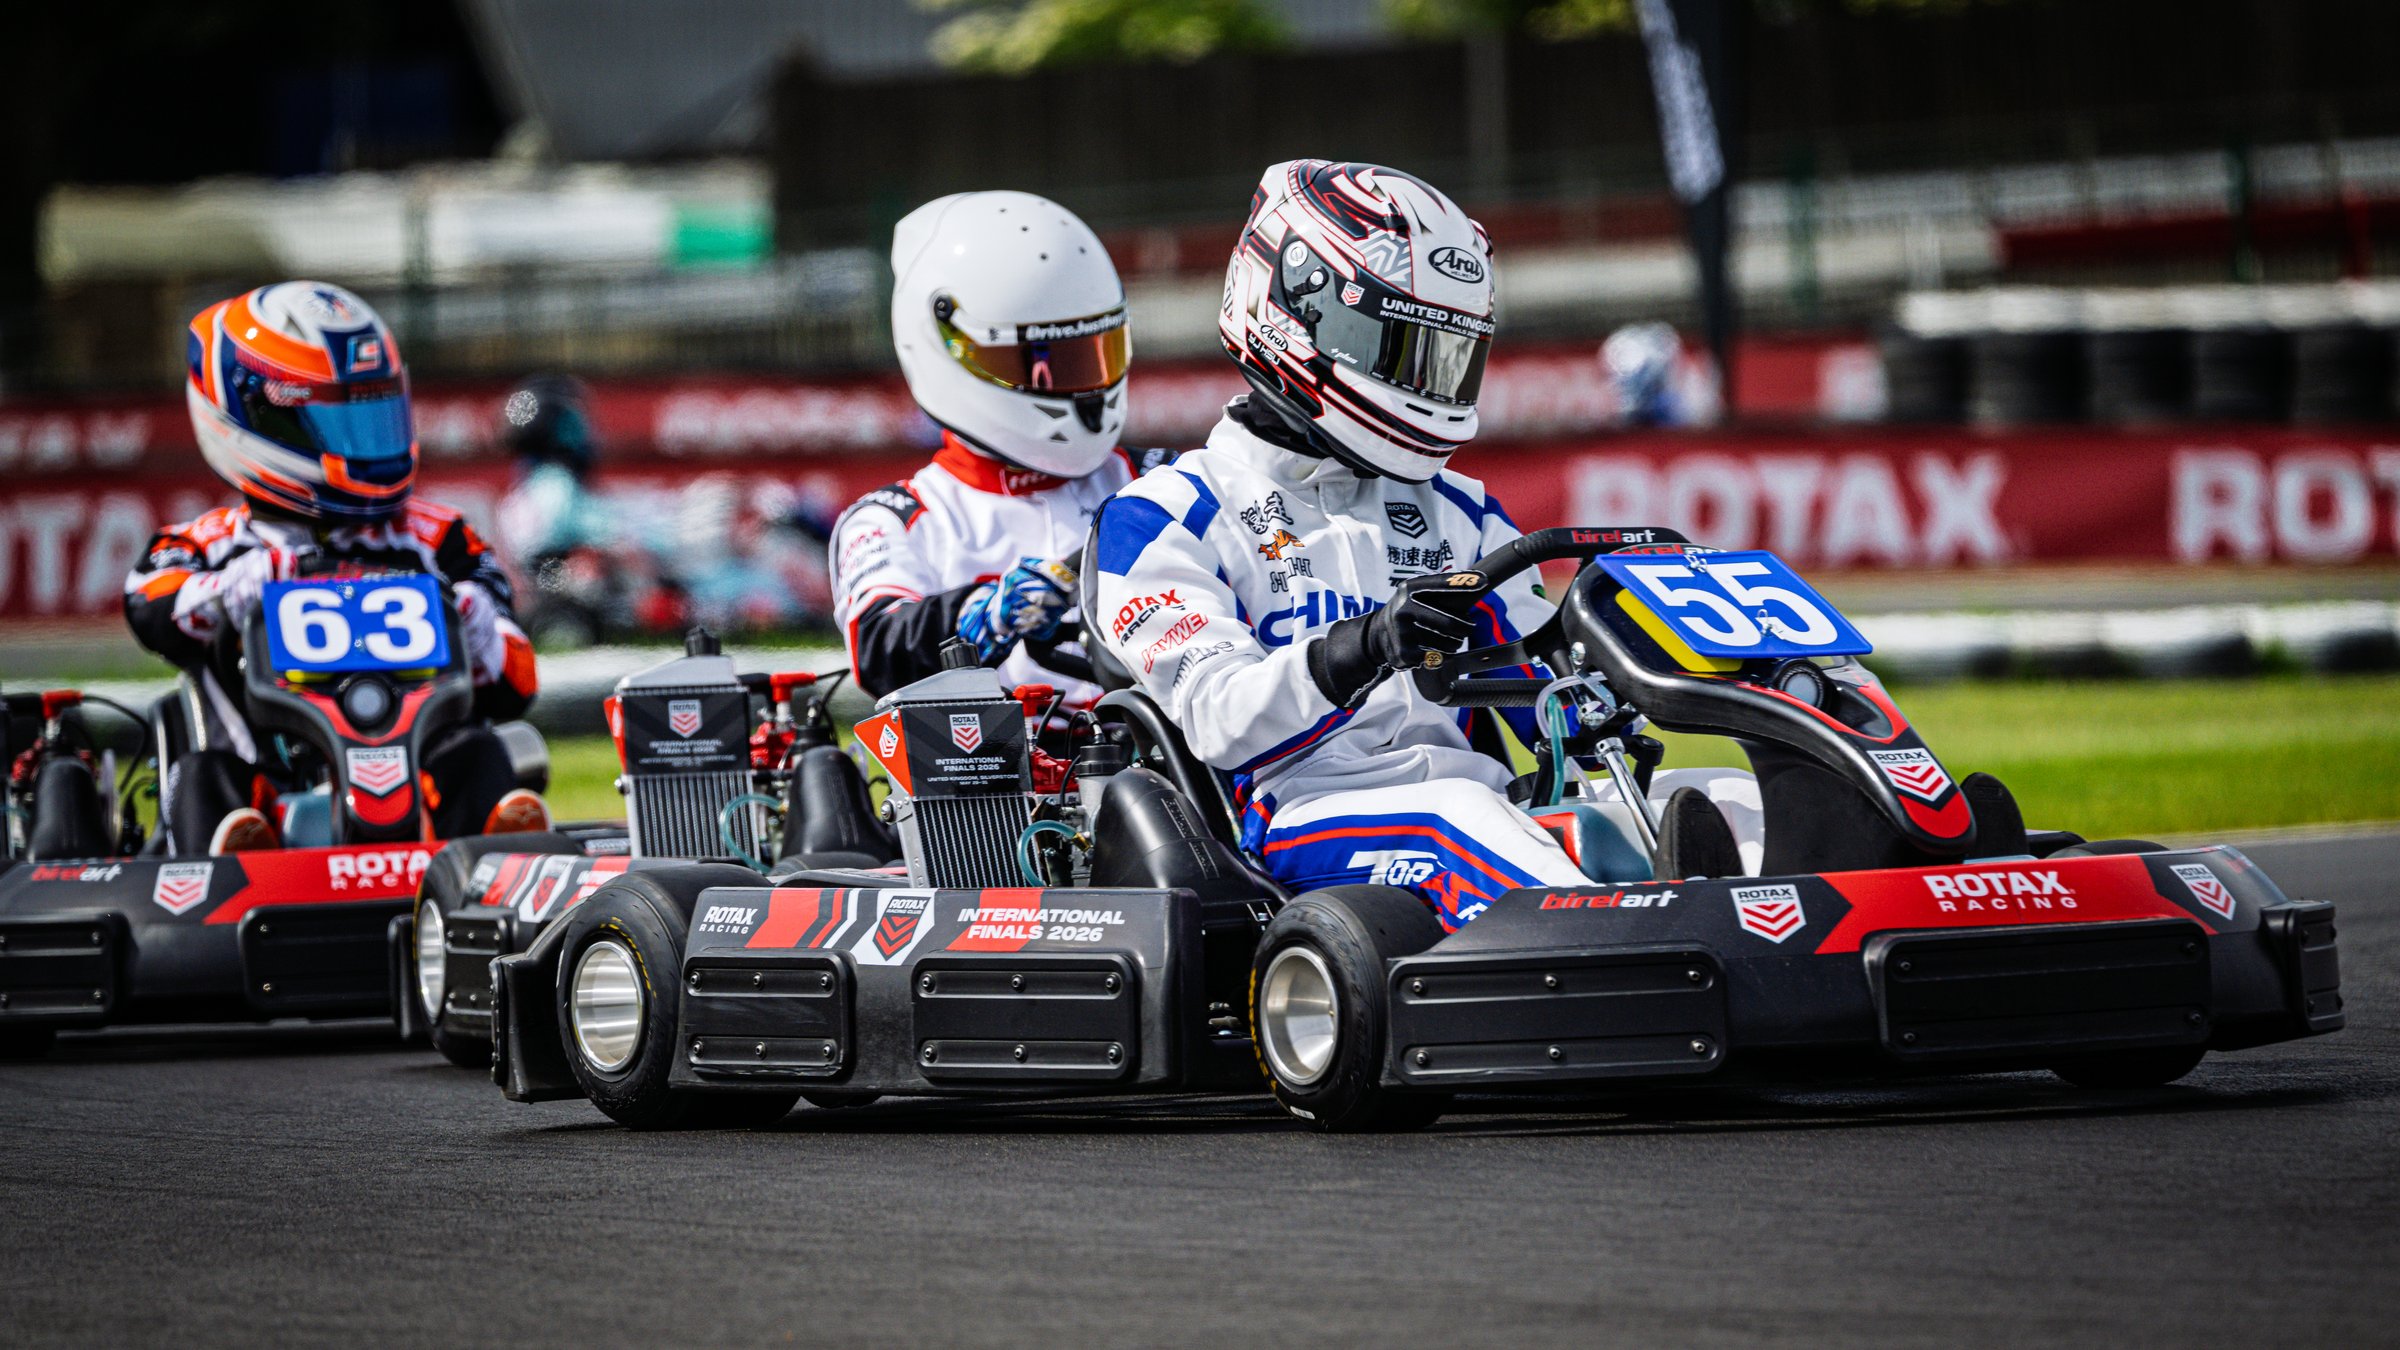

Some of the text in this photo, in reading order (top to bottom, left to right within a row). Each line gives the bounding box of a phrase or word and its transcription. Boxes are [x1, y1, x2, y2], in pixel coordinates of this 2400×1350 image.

[1434, 249, 1480, 276] Arai
[1381, 297, 1449, 322] UNITED
[1379, 310, 1443, 329] INTERNATIONAL
[1443, 324, 1467, 336] FINALS
[1262, 328, 1286, 348] Arai
[1386, 504, 1417, 512] ROTAX
[1570, 450, 2012, 563] ROTAX
[1571, 529, 1656, 544] birelart
[1624, 561, 1838, 647] 55
[1112, 588, 1183, 640] ROTAX
[1258, 589, 1387, 647] CHIN
[278, 586, 436, 664] 63
[935, 756, 1006, 765] INTERNATIONAL
[1874, 751, 1927, 761] ROTAX
[943, 763, 1000, 772] FINALS 2026
[31, 863, 122, 882] birelart
[1737, 887, 1795, 899] ROTAX
[1922, 870, 2071, 899] ROTAX
[888, 898, 927, 910] ROTAX
[1539, 890, 1679, 910] birelart
[1938, 896, 2079, 912] RACING
[703, 905, 759, 925] ROTAX
[957, 908, 1126, 925] INTERNATIONAL
[698, 923, 750, 935] RACING
[967, 924, 1104, 942] FINALS 2026
